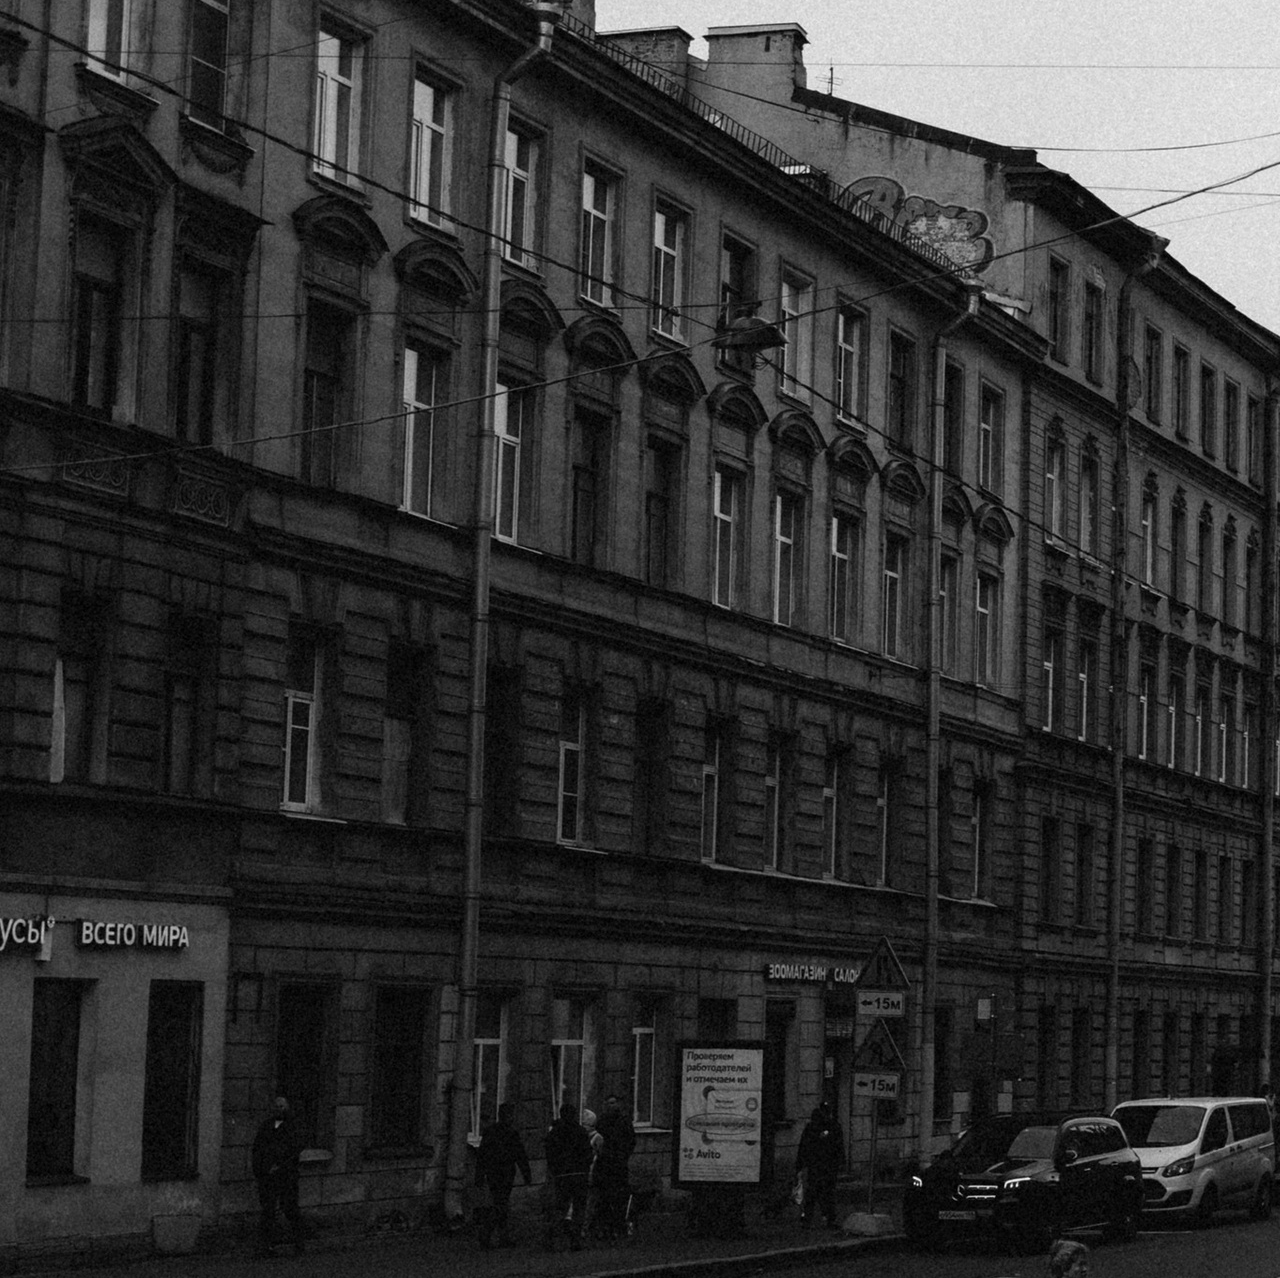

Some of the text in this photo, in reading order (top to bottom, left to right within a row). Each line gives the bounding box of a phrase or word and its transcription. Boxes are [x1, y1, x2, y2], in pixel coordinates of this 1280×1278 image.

[82, 921, 135, 946] ВСЕГО
[143, 924, 190, 948] МИРА
[768, 963, 827, 981] ЗООМАГАЗИН
[686, 1051, 735, 1062] Проверяем
[686, 1062, 752, 1073] работодателей
[693, 1076, 736, 1084] отмечаем
[737, 1076, 748, 1084] их
[696, 1148, 721, 1159] Avito
